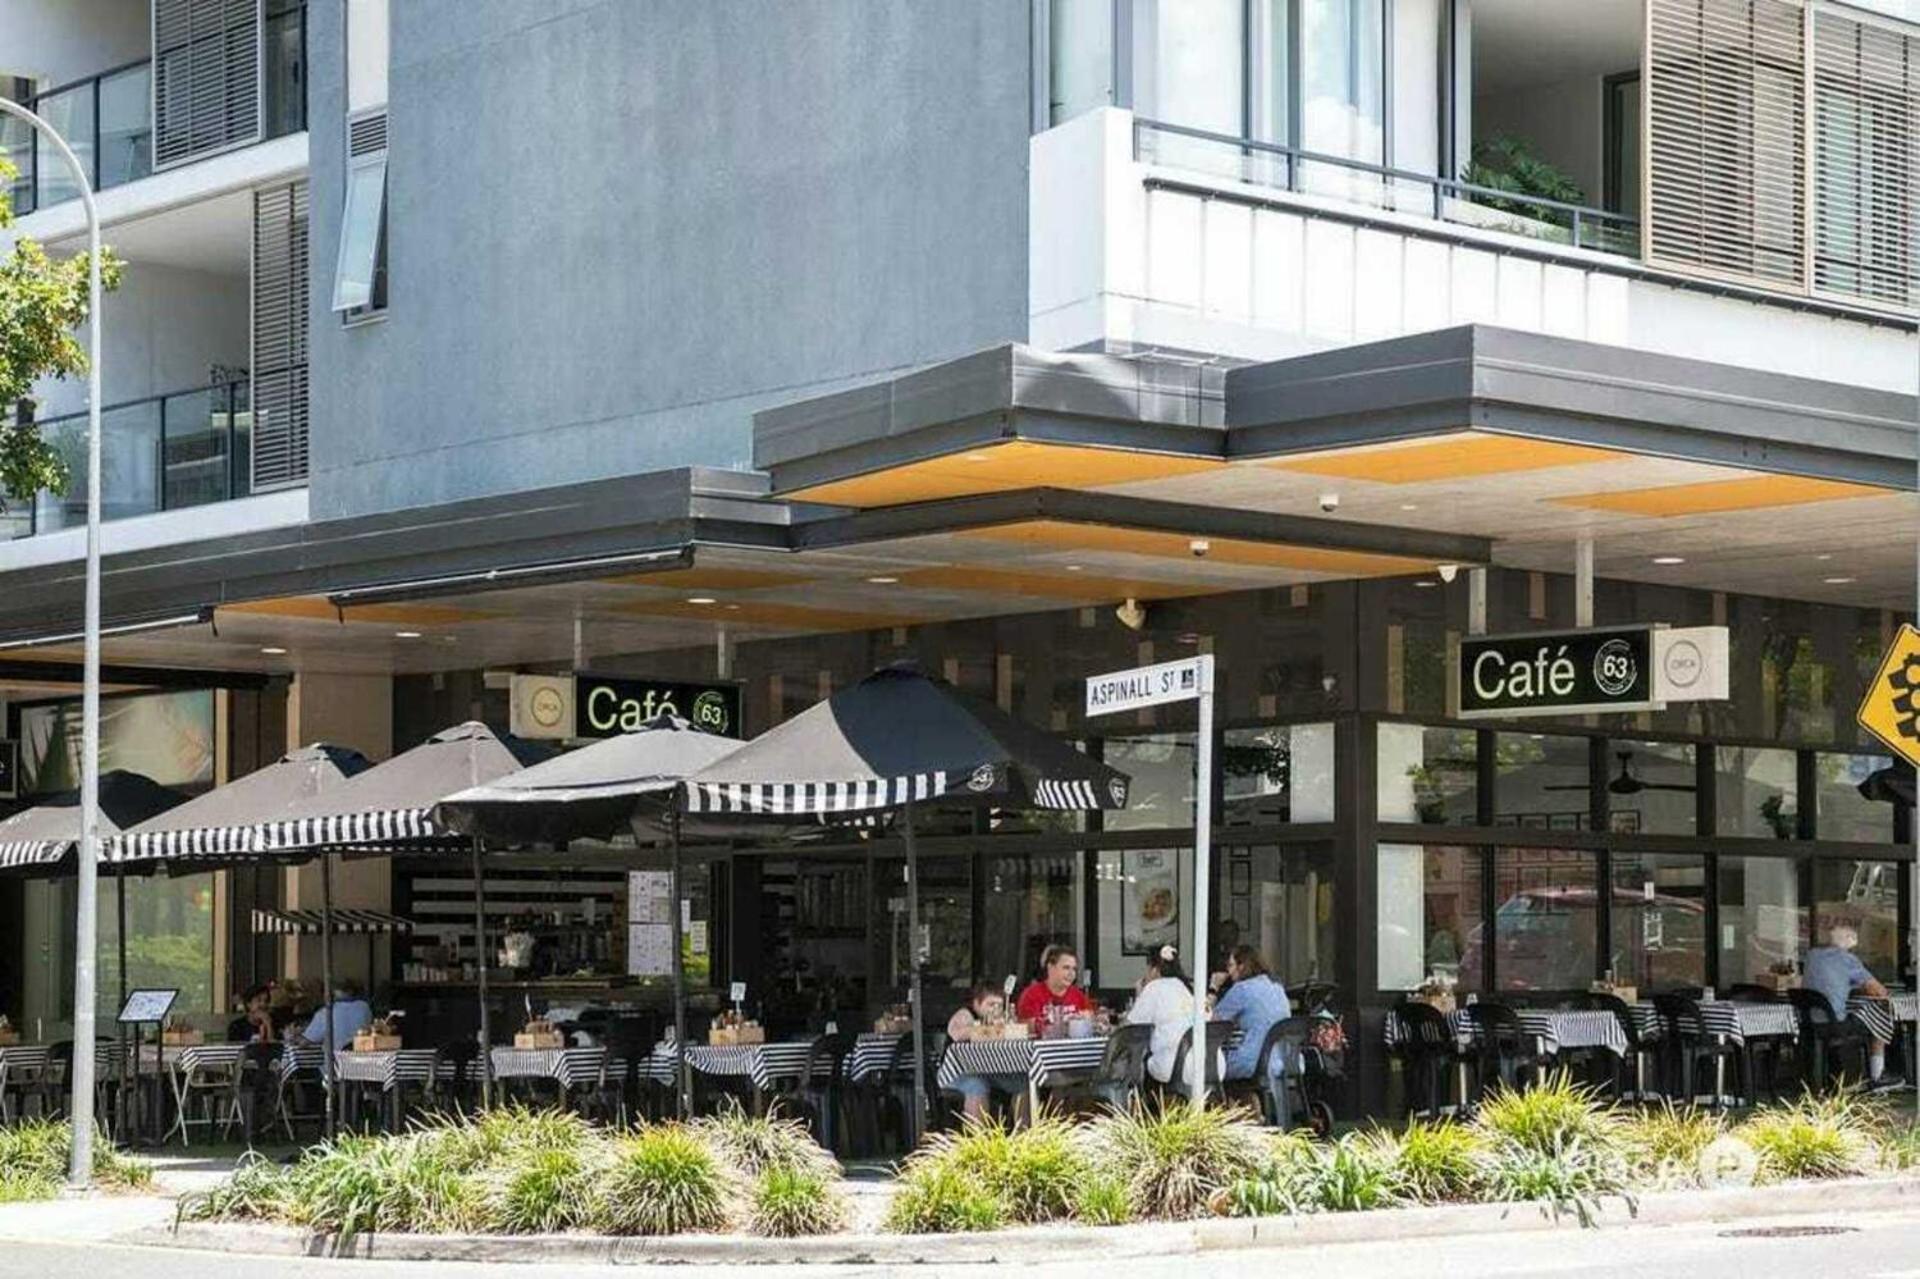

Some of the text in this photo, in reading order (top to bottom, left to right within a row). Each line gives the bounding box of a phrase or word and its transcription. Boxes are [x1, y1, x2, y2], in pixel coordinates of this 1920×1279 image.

[1473, 645, 1628, 700] Café 63
[1091, 676, 1152, 705] ASPINALL
[702, 703, 721, 725] 63
